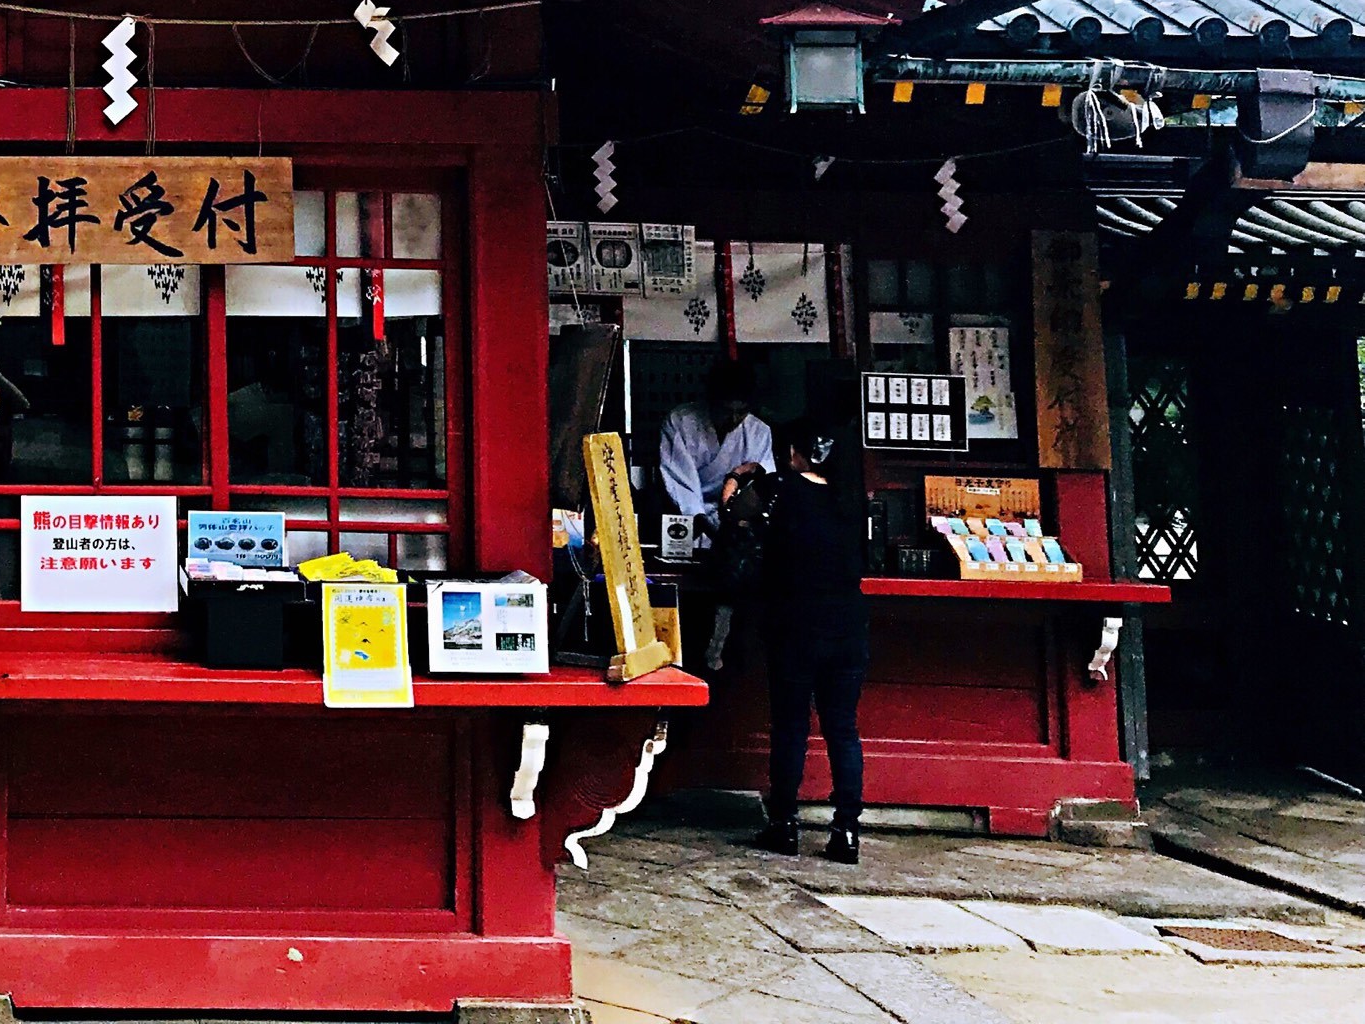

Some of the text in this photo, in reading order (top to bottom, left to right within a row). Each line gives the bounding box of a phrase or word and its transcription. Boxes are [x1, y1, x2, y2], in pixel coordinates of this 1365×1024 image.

[33, 511, 160, 531] 熊の目撃情報あり
[53, 538, 137, 551] 登山者の方は、
[40, 557, 156, 571] 注意願います
